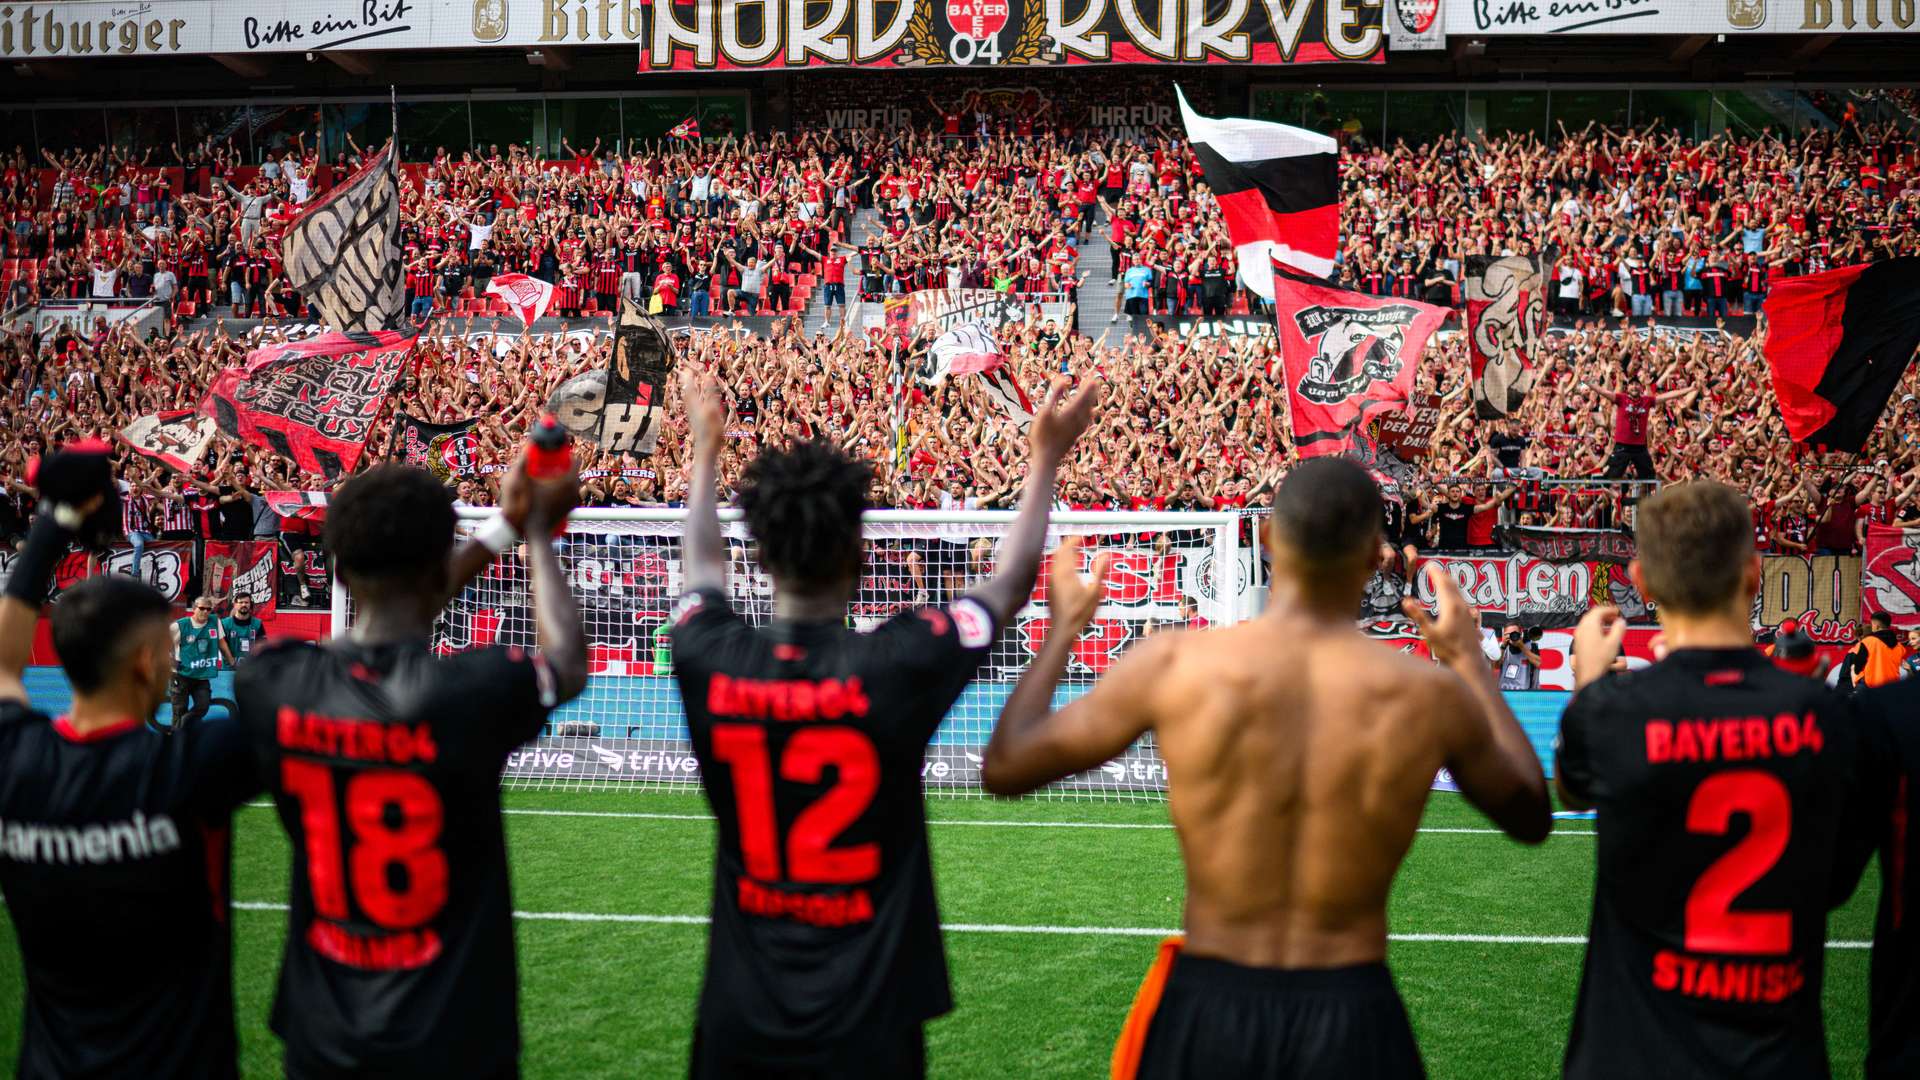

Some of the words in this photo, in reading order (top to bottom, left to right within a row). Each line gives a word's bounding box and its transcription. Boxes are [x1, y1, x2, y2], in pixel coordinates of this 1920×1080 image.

[244, 17, 304, 49] Bitte
[311, 14, 357, 35] ein
[363, 0, 413, 27] Bit
[949, 4, 1006, 16] BAYER
[1474, 0, 1542, 30] Bitte
[949, 31, 1002, 66] 04
[825, 109, 868, 129] WIR
[871, 104, 913, 129] FÜR
[1091, 106, 1128, 125] IHR
[1130, 101, 1173, 126] FÜR
[1382, 420, 1409, 433] DER
[1411, 424, 1433, 436] IST
[232, 549, 274, 589] FREIHEIT
[253, 575, 268, 593] DIE
[1797, 609, 1857, 644] Aus
[190, 656, 218, 669] HOST
[507, 747, 575, 769] trive
[629, 748, 699, 772] trive
[711, 722, 881, 884] 12
[280, 756, 450, 930] 18
[1683, 768, 1794, 955] 2
